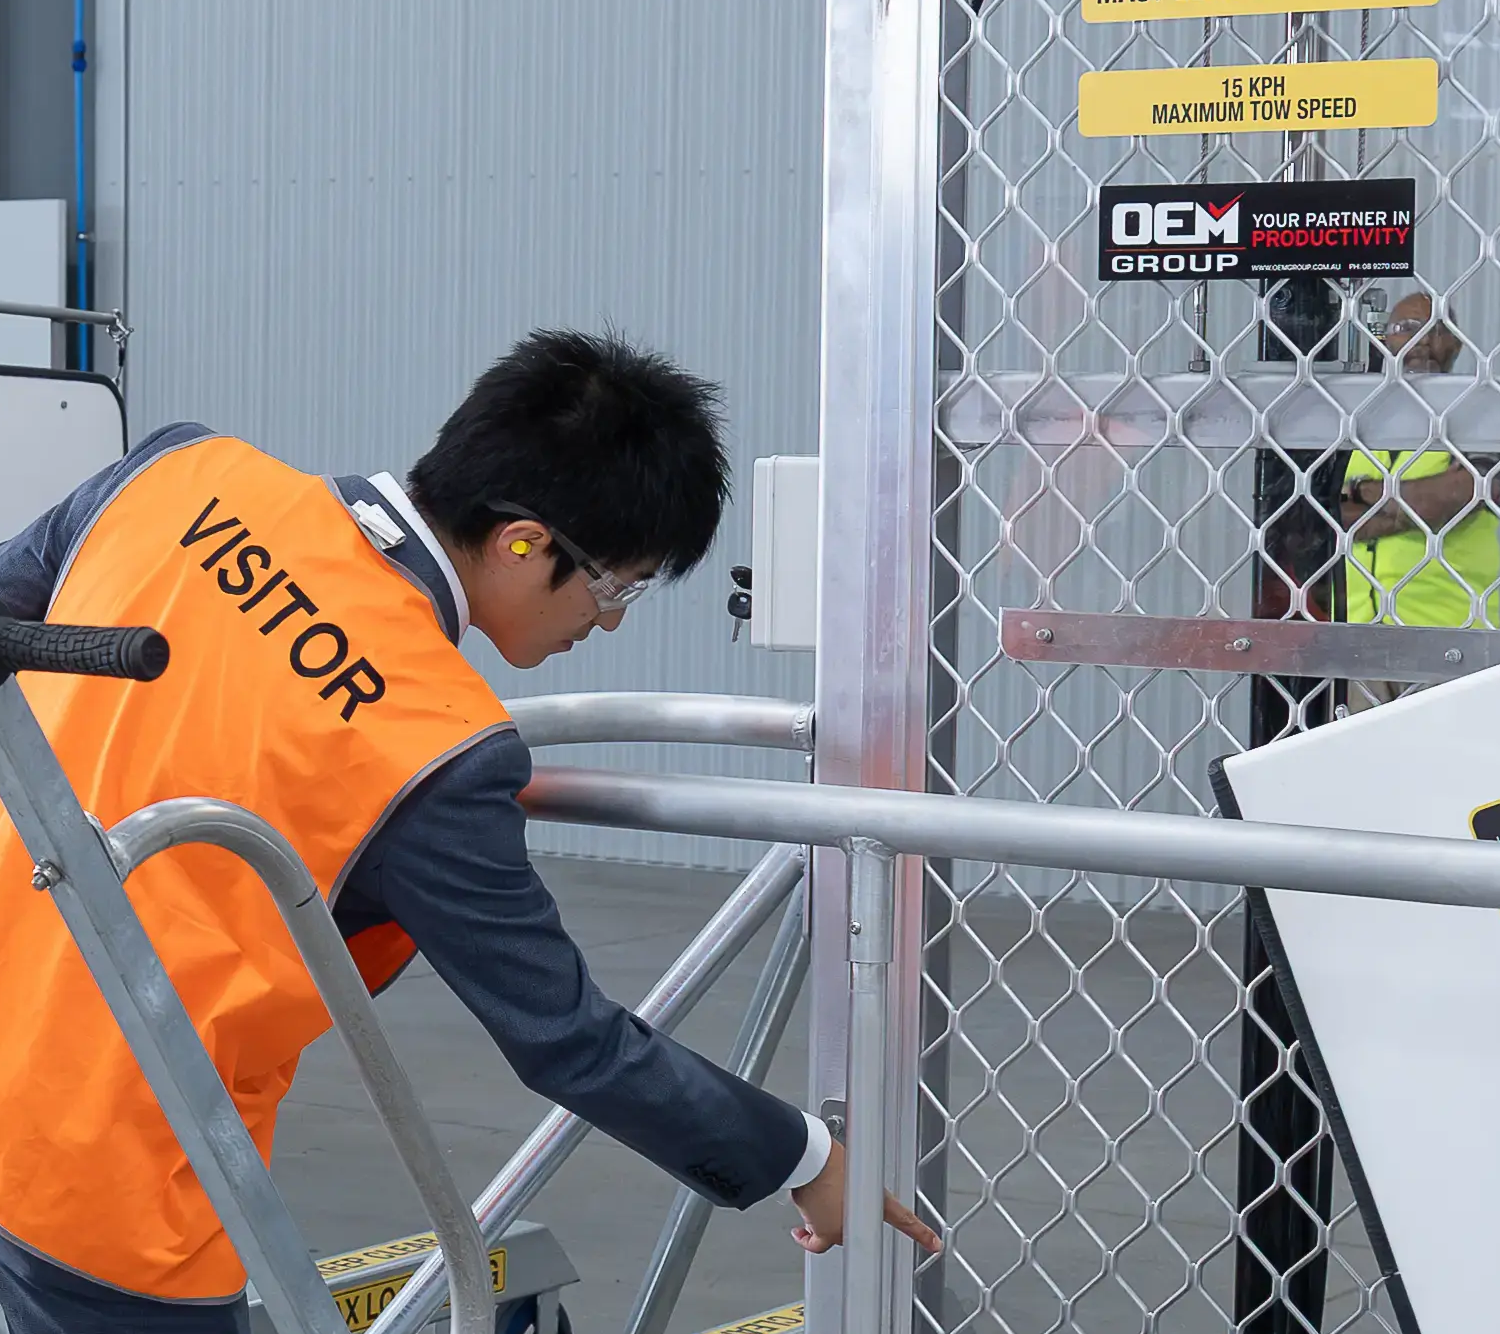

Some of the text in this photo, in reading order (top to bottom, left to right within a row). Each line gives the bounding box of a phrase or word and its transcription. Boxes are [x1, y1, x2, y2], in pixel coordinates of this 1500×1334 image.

[1221, 77, 1286, 98] 15 KPH
[1152, 97, 1358, 126] MAXIMUM TOW SPEED
[1112, 201, 1240, 245] OEM
[1252, 210, 1410, 228] YOUR PARTNER IN
[1252, 228, 1410, 248] PRODUCTIVITY
[1112, 254, 1239, 273] GROUP
[179, 497, 386, 723] VISITOR
[365, 1237, 439, 1261] CLEAR
